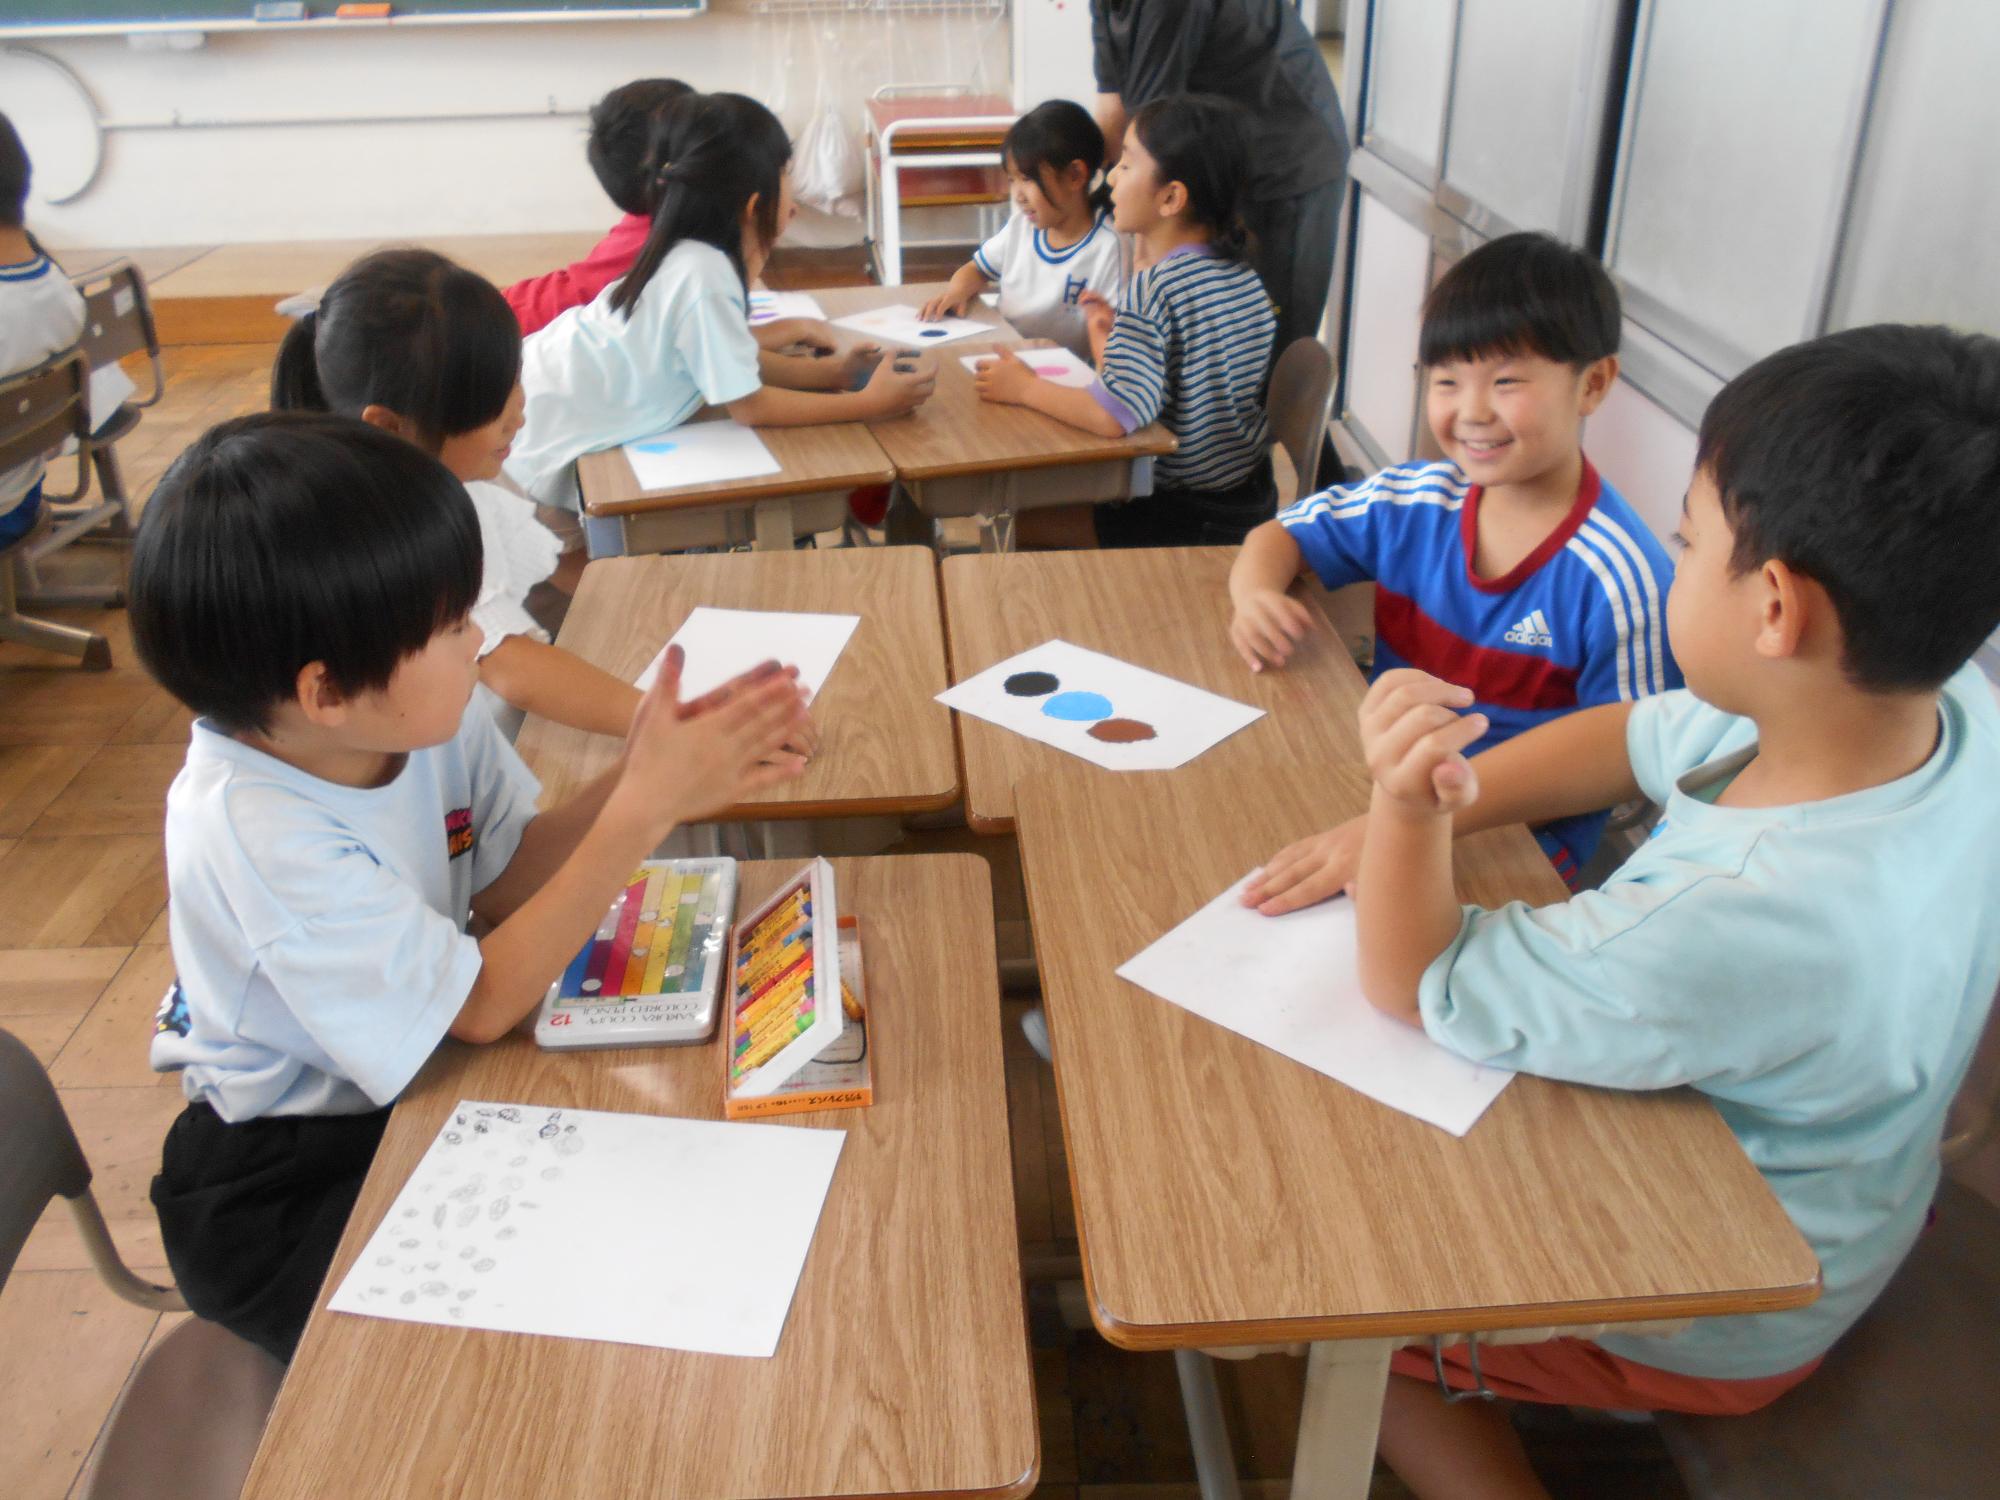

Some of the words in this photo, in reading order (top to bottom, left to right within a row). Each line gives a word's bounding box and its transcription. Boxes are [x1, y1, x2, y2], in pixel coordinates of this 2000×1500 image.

[631, 1002, 699, 1014] COLORED
[550, 1013, 572, 1026] 12
[642, 1012, 696, 1023] SAKURA
